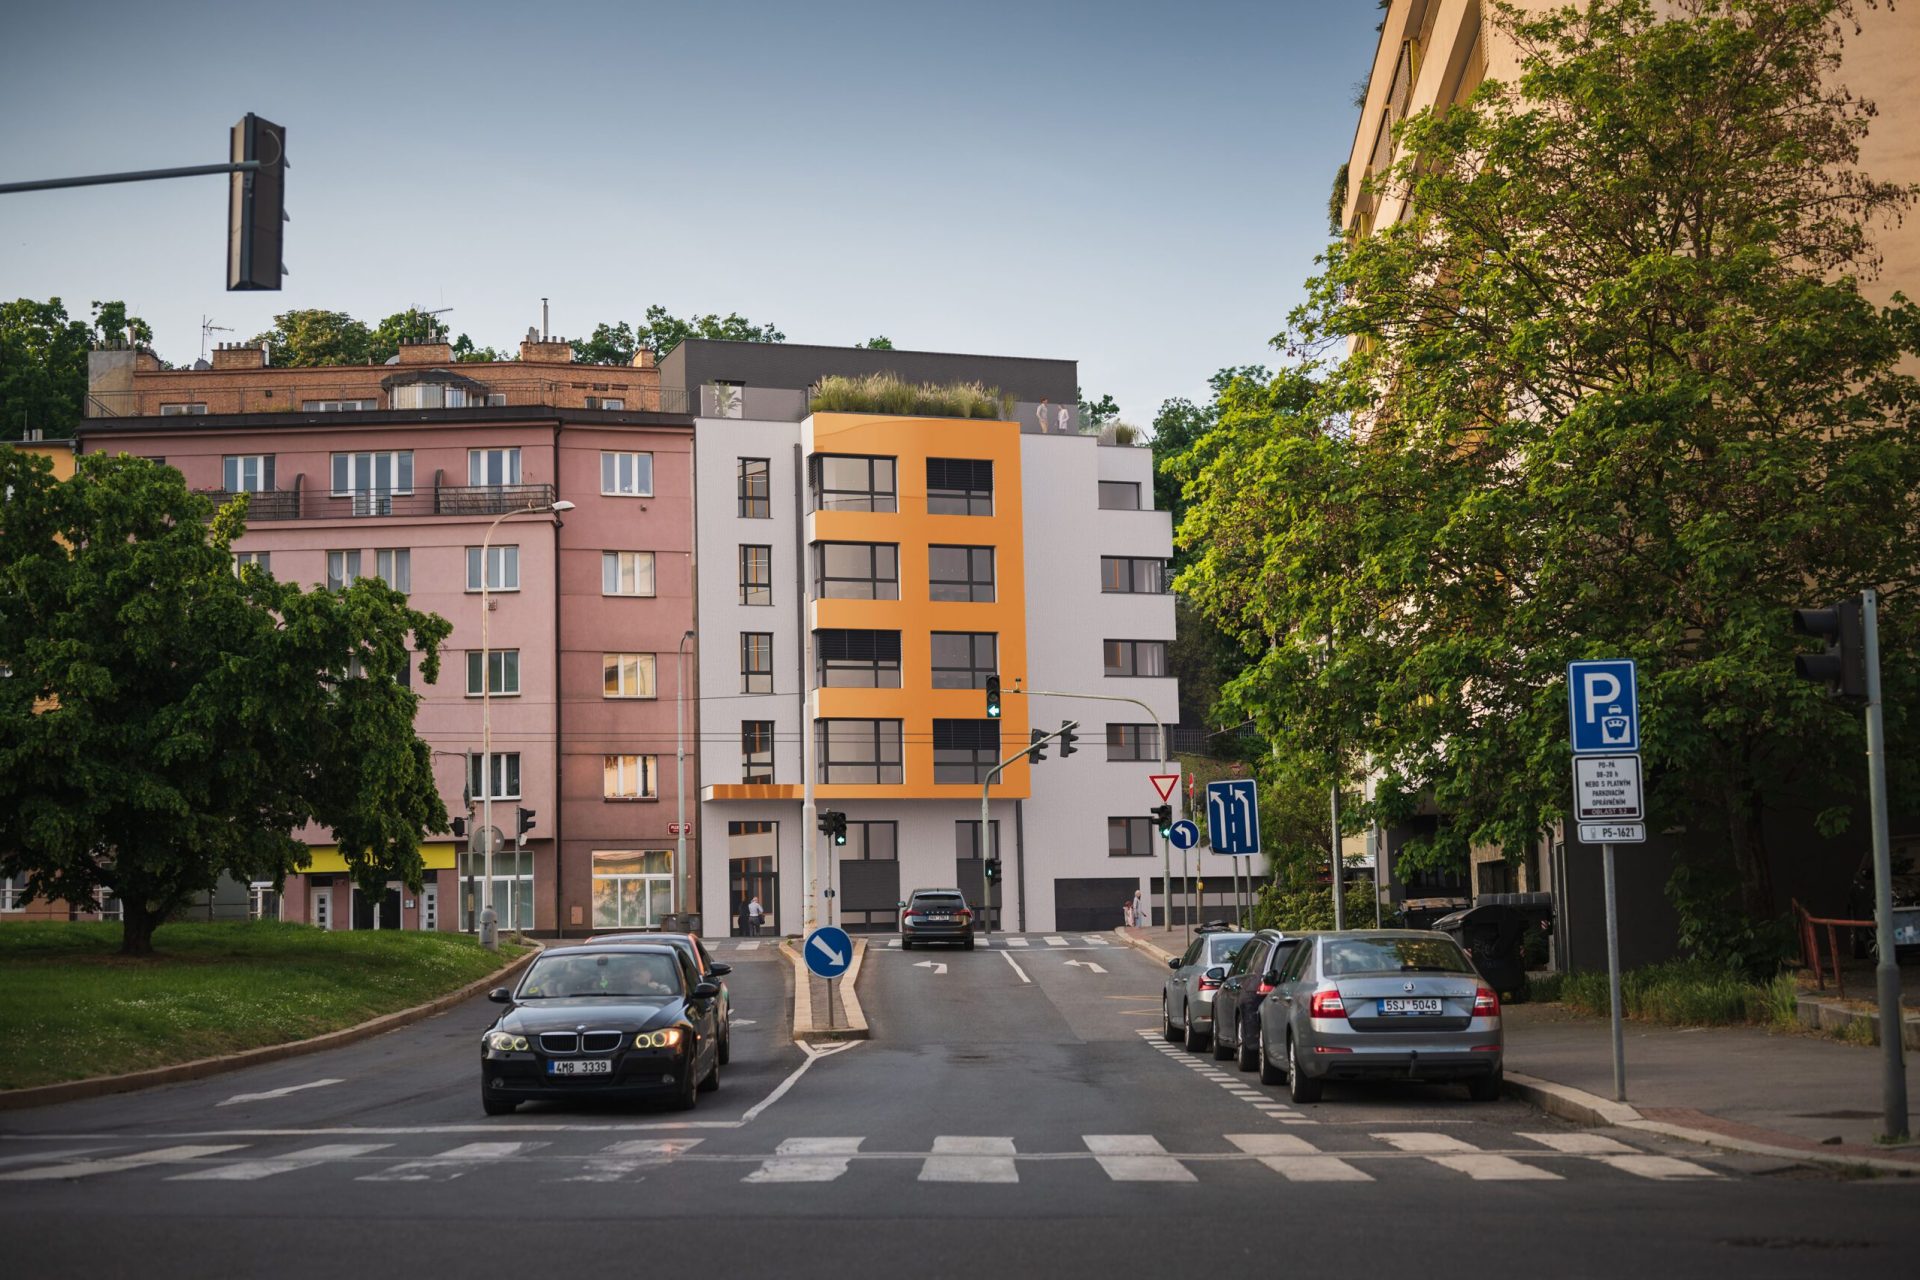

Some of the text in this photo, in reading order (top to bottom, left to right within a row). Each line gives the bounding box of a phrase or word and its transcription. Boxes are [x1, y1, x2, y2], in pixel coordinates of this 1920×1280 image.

[1584, 672, 1621, 724] P
[1598, 760, 1615, 768] PO-PÁ
[1585, 780, 1599, 788] NEBO
[1602, 827, 1634, 838] P5-1621
[1386, 999, 1437, 1011] 5SJ 5048
[581, 1061, 607, 1072] 3339
